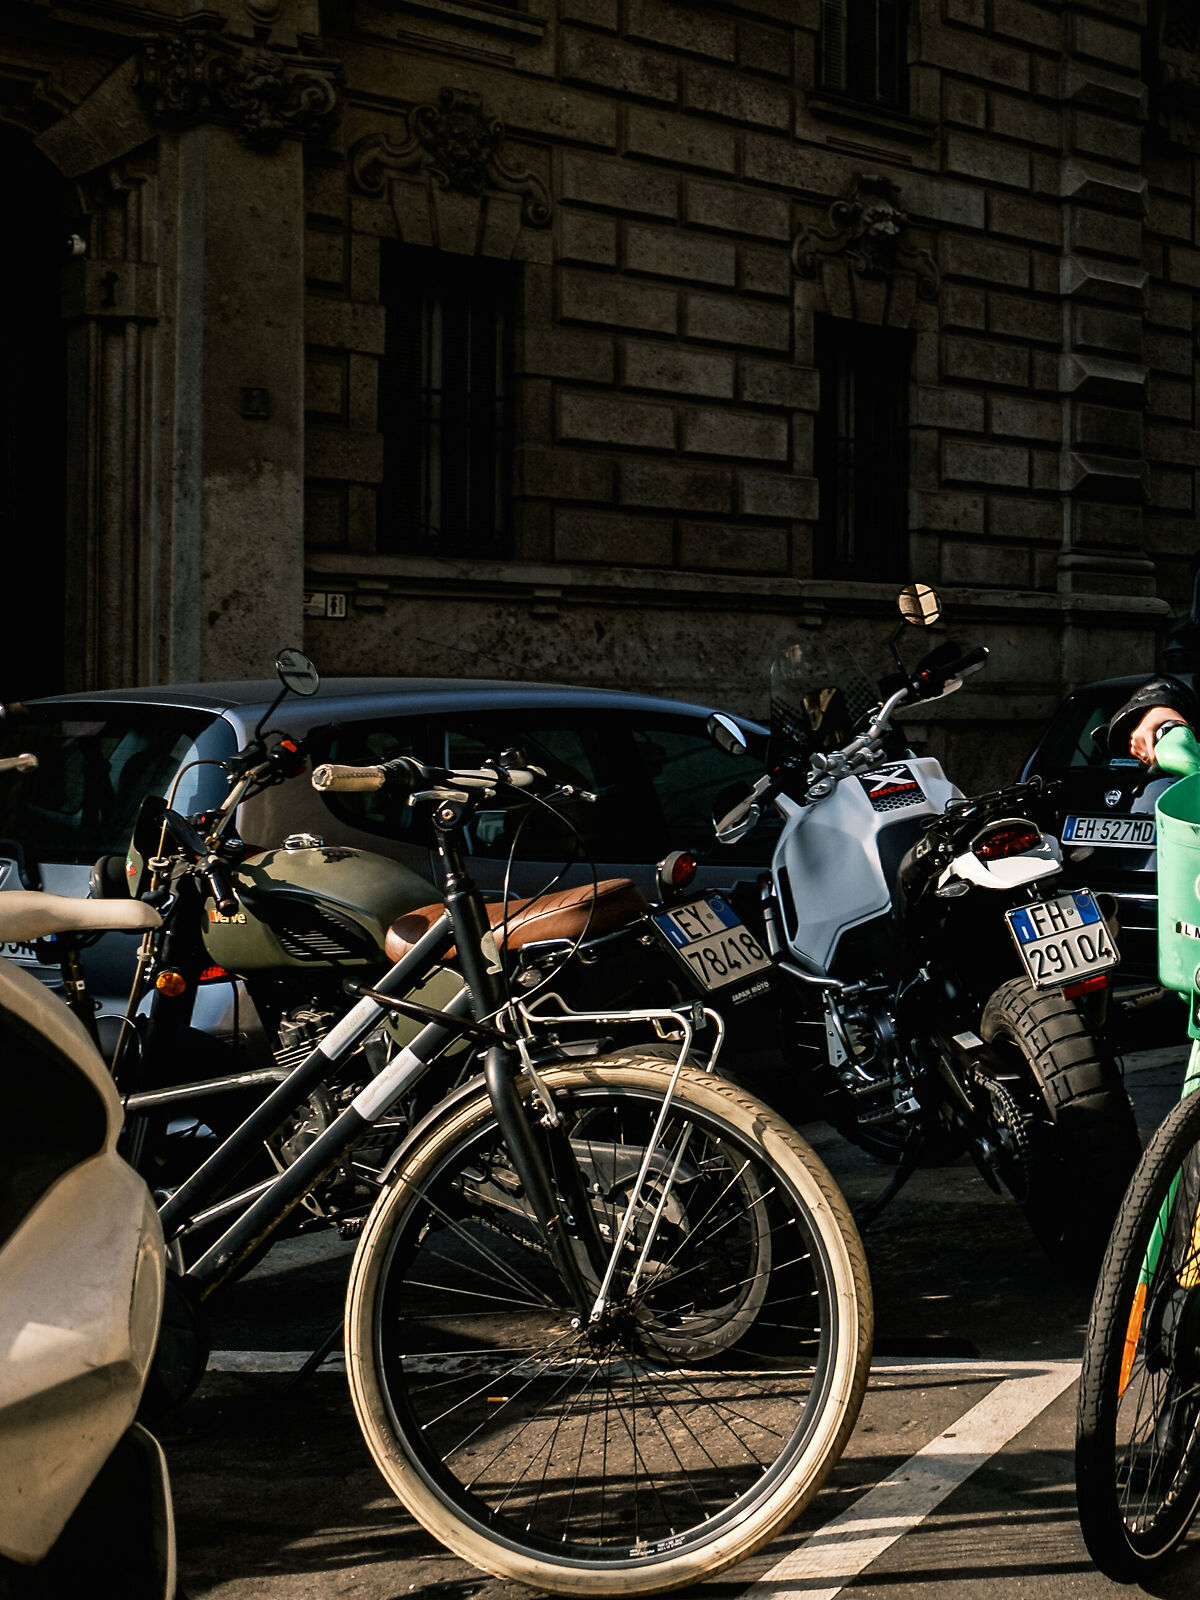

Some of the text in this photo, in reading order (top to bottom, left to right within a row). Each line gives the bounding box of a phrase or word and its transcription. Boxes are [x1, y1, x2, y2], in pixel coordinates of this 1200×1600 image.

[869, 783, 917, 798] DUCATI
[1074, 819, 1154, 842] EH 527MD
[671, 905, 711, 940] EY
[1029, 901, 1070, 937] FH
[687, 932, 765, 983] 78418
[1028, 928, 1113, 980] 29104
[731, 988, 751, 1002] JAPAN
[751, 981, 770, 993] MOTO
